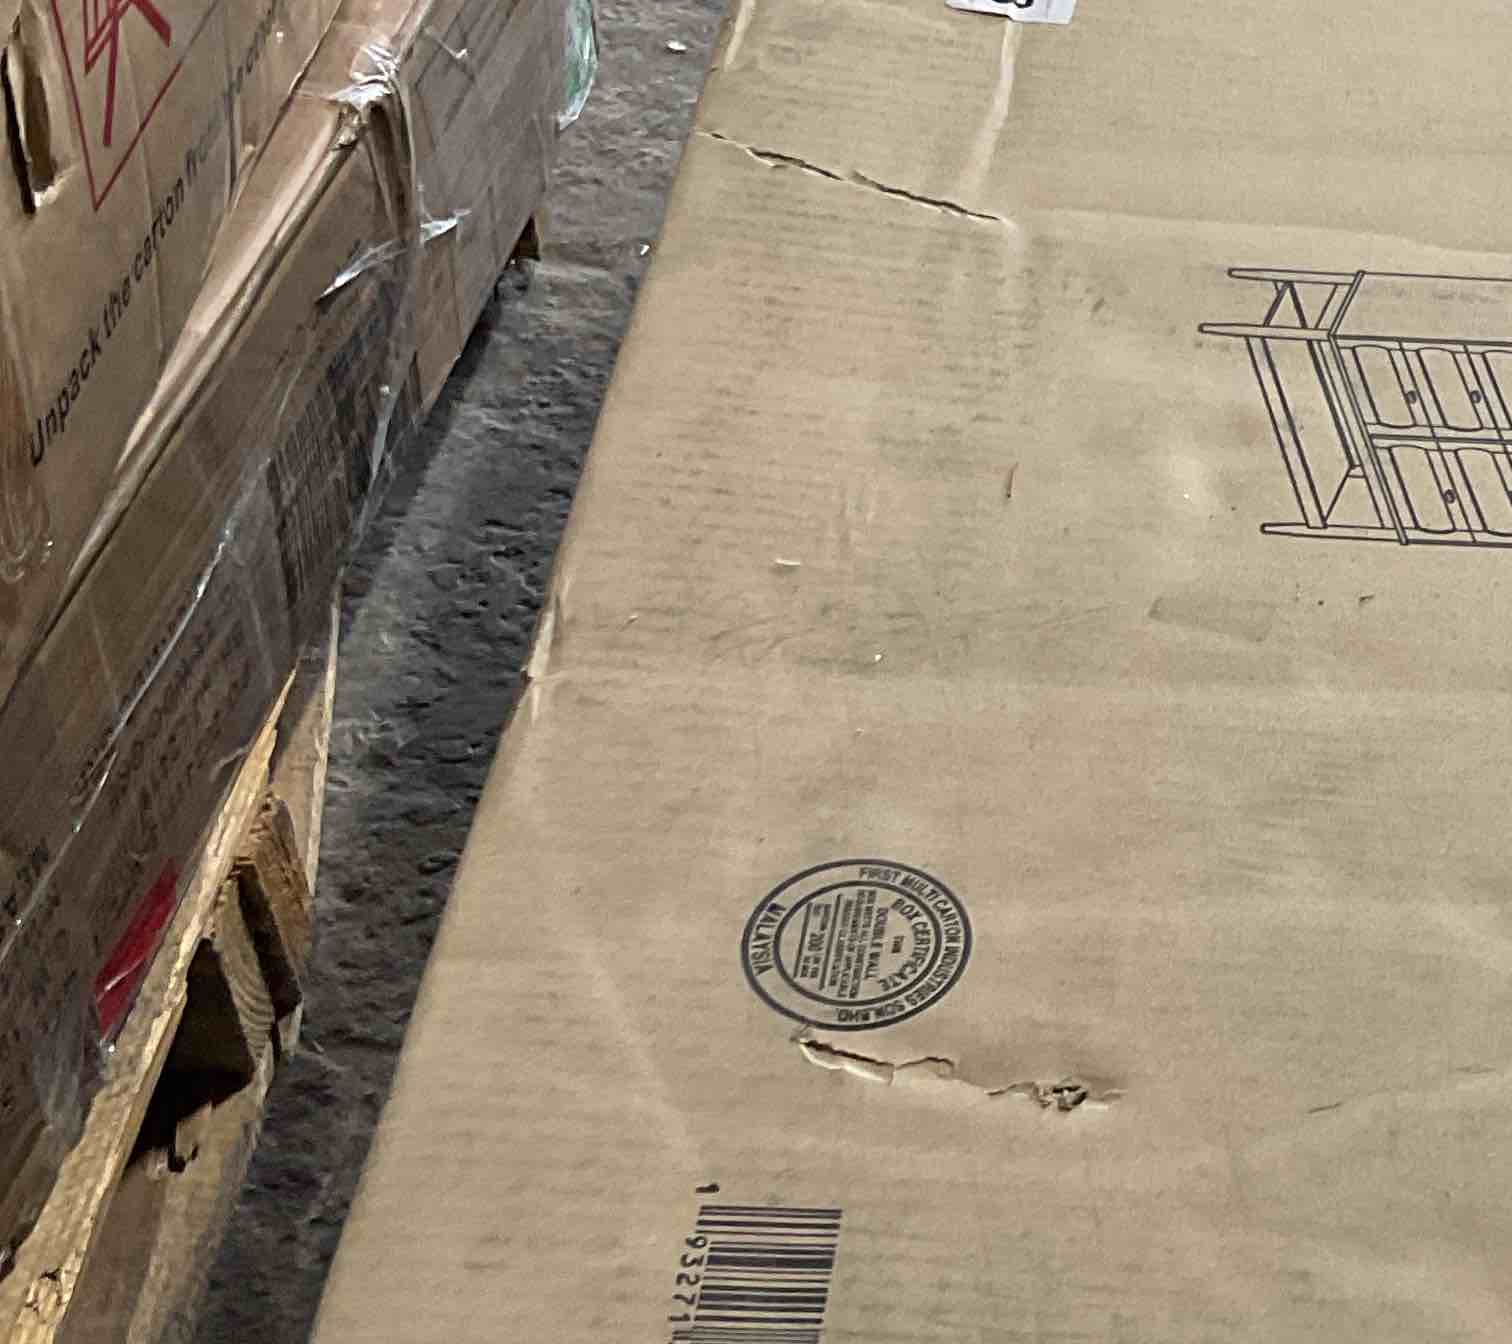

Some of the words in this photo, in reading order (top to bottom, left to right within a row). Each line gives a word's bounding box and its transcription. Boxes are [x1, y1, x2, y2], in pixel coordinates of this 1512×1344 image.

[29, 330, 101, 466] Unpack
[101, 283, 130, 339] the
[130, 175, 185, 281] carton
[859, 867, 901, 883] FIRST
[902, 873, 936, 902] MULTI
[870, 906, 888, 949] DOUBLE
[891, 897, 920, 924] BOX
[935, 901, 961, 945] CARTON
[751, 903, 787, 976] MALAYSIA
[878, 922, 930, 992] CERTIFICATE
[864, 951, 881, 980] WALL
[904, 946, 961, 1005] INDUSTRIES
[696, 1183, 720, 1193] 1
[668, 1235, 708, 1322] 93271
